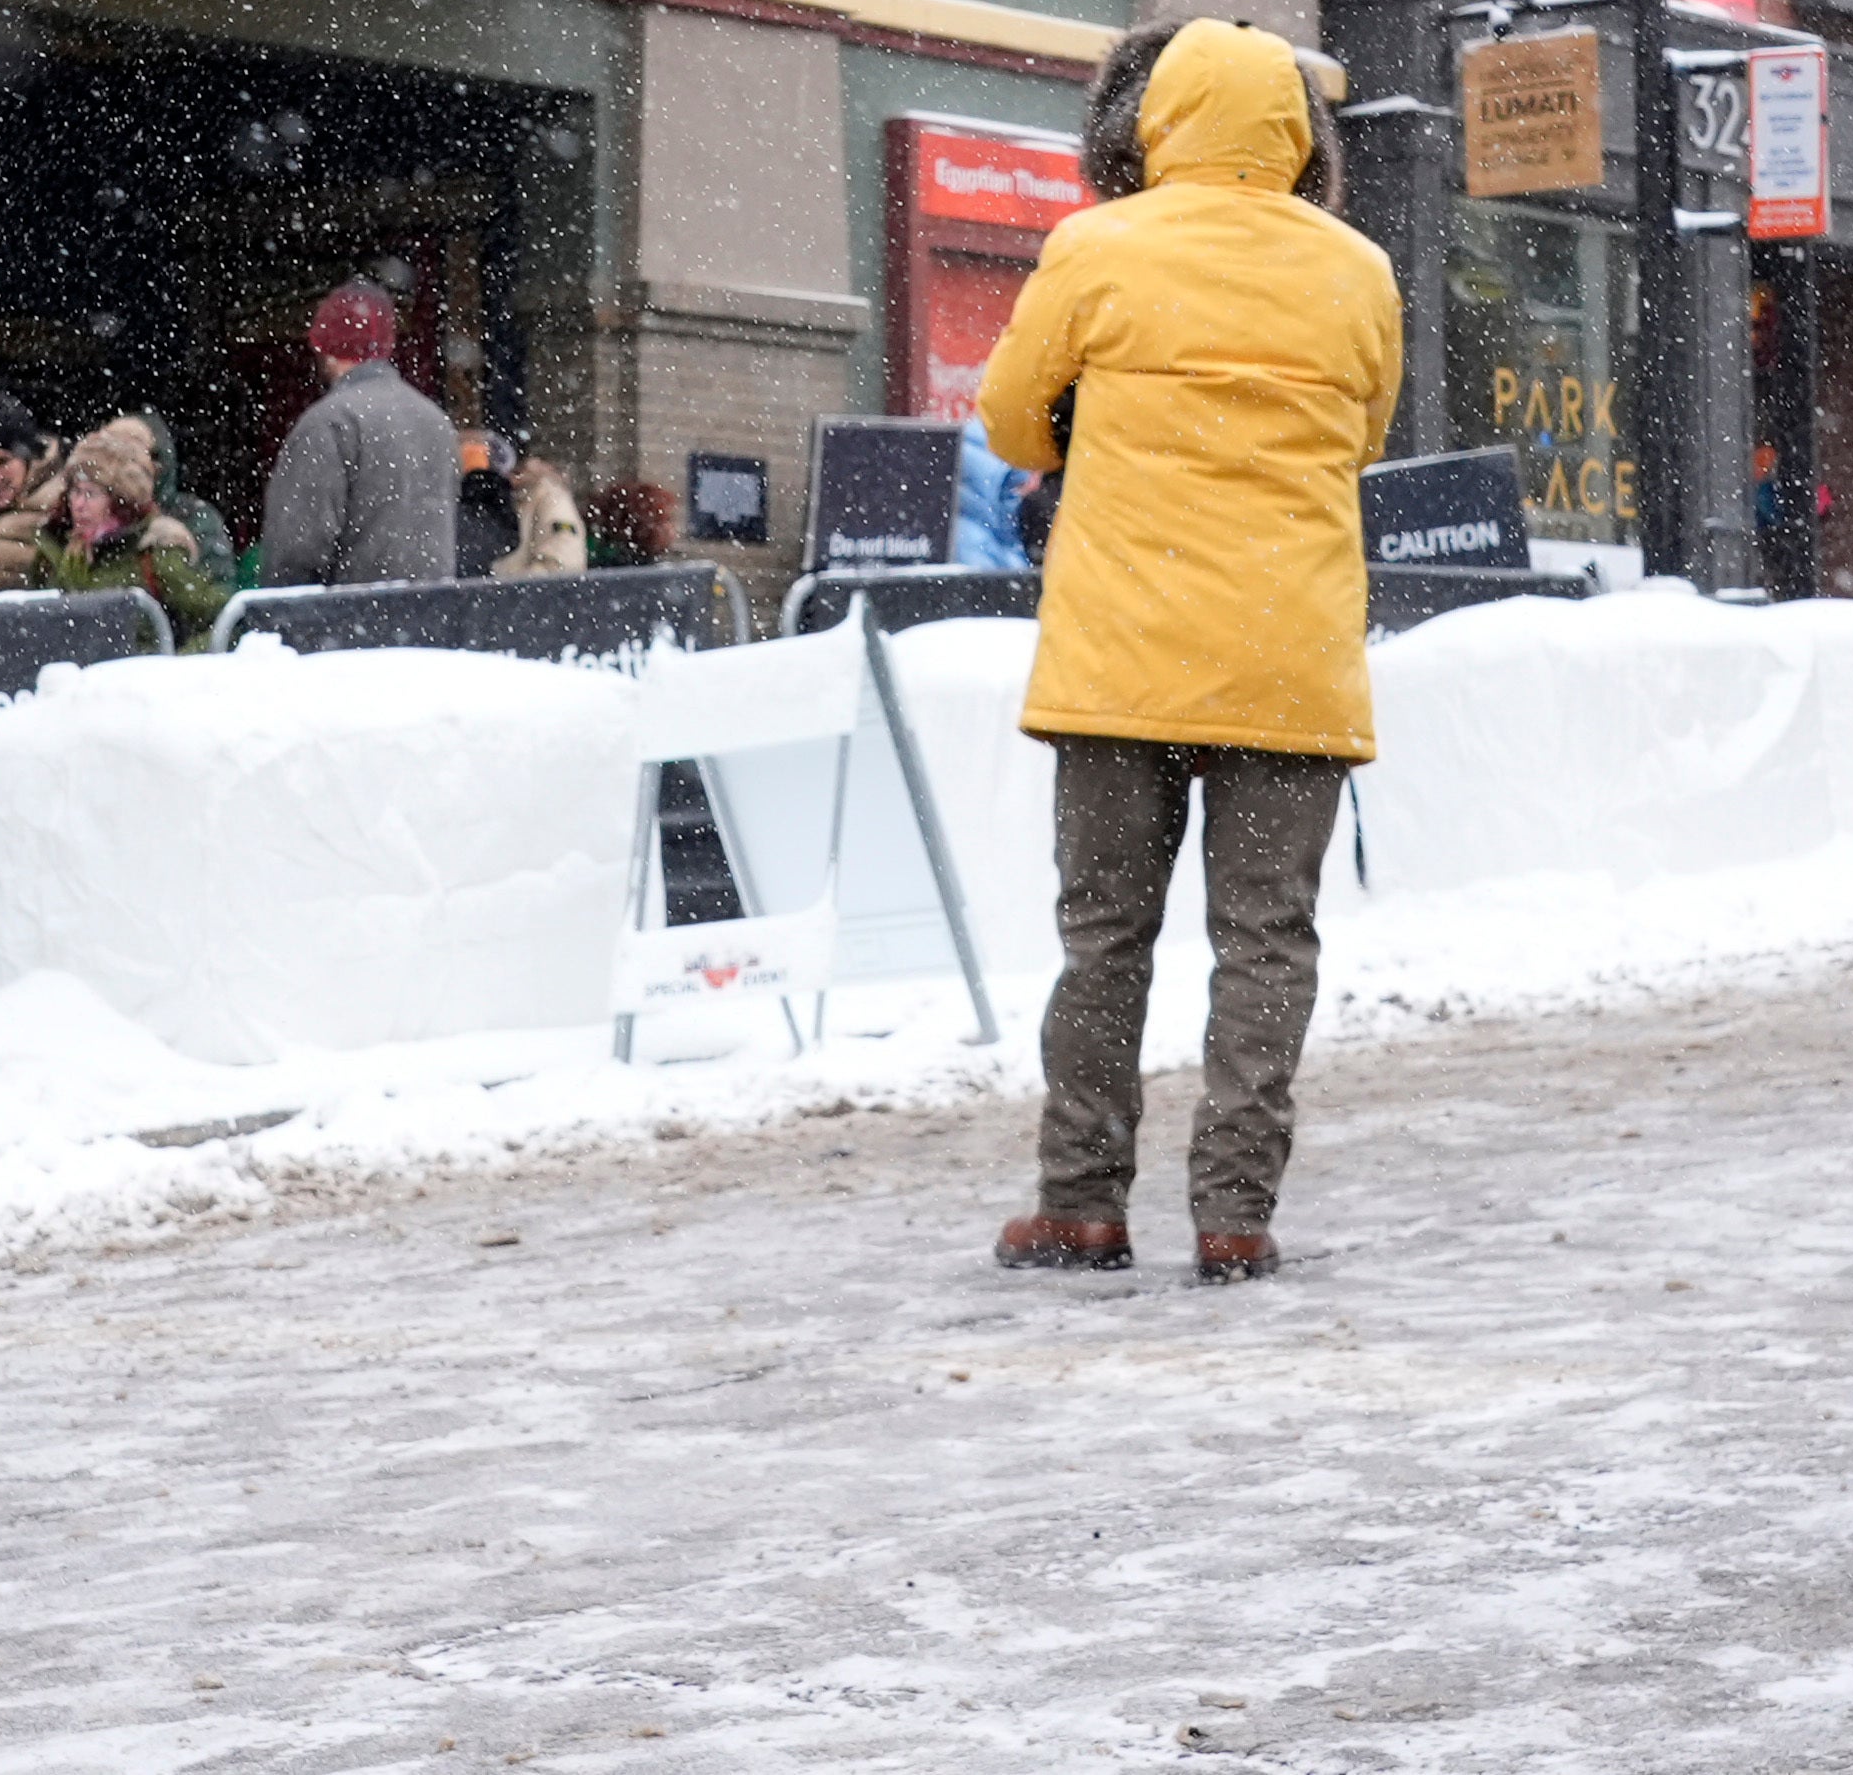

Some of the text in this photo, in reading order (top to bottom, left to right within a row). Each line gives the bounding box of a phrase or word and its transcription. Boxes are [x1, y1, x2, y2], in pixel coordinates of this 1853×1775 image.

[1688, 73, 1751, 159] 32
[934, 156, 1083, 205] Egyptian Theatre
[1494, 366, 1619, 438] PARK
[1522, 458, 1639, 520] ACE
[828, 531, 932, 559] Do not block
[1378, 520, 1501, 563] CAUTION
